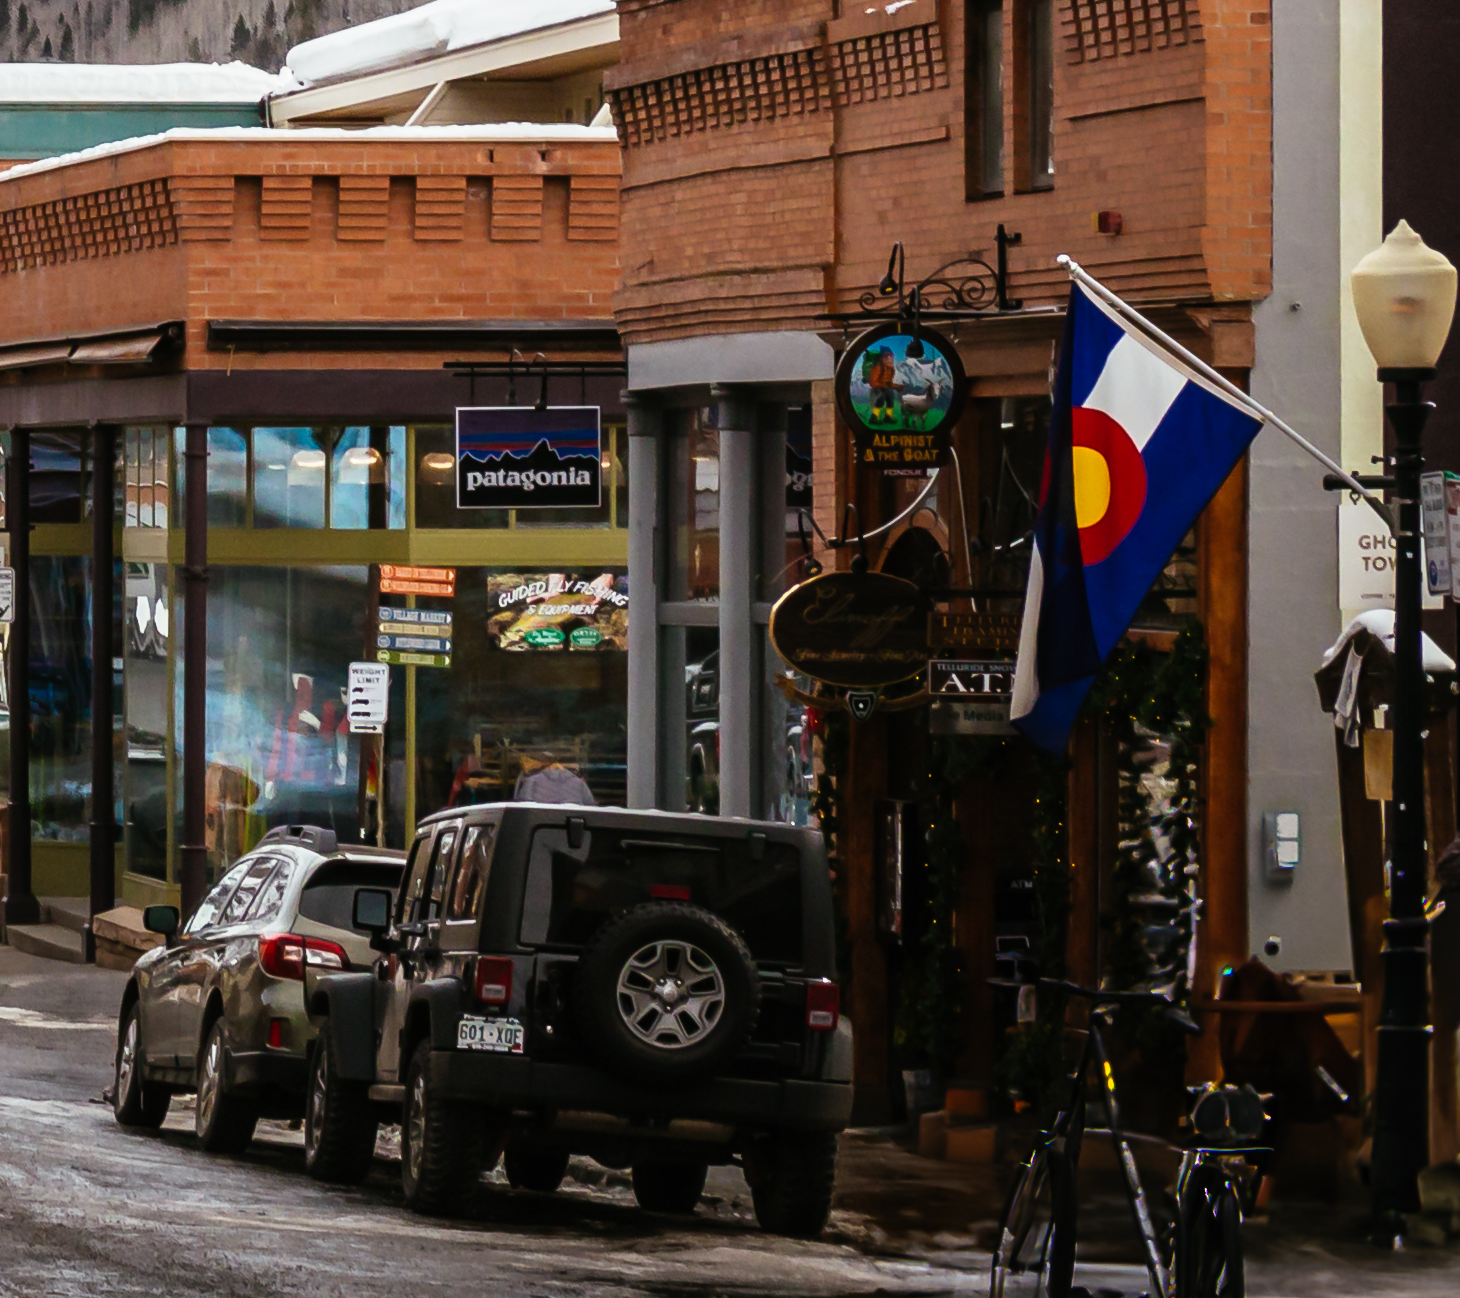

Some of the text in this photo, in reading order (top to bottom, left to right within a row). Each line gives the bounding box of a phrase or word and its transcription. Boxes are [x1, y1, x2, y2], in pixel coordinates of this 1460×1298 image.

[872, 433, 935, 447] ALPINIST
[878, 450, 899, 461] THE
[903, 448, 940, 462] GOAT
[466, 466, 592, 492] patagonia
[883, 468, 922, 477] FONDUE
[1358, 534, 1397, 551] GHO
[1361, 556, 1396, 572] TO
[498, 581, 547, 608] GUIDED
[572, 580, 630, 607] FISHING
[537, 604, 599, 616] EQUIPMENT
[351, 668, 386, 676] WEIGHT
[937, 663, 985, 672] TELLURIDE
[1010, 879, 1034, 889] ATM
